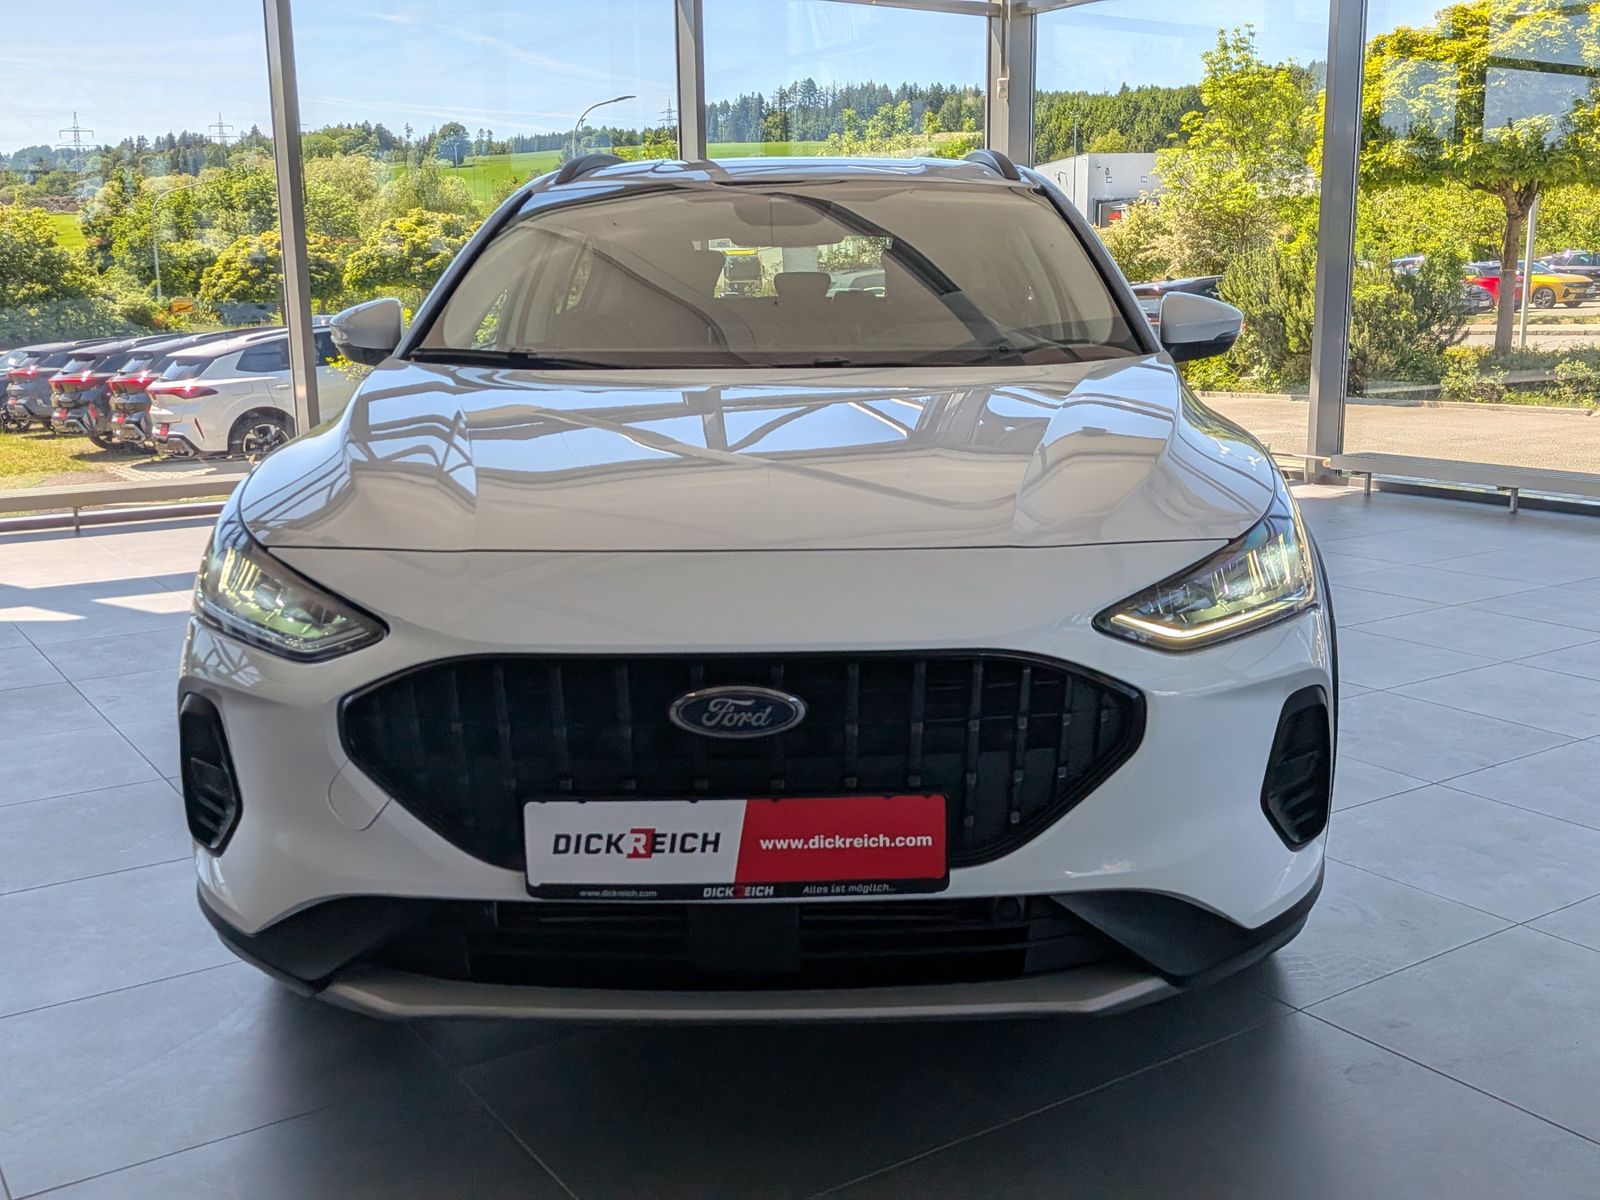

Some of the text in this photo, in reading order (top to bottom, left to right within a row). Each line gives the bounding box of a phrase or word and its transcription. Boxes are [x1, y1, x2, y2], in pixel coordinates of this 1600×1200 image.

[702, 698, 772, 727] Ford
[552, 830, 721, 857] DICKREICH
[760, 834, 932, 850] www.dickreich.com
[703, 886, 774, 898] DICKEICH
[803, 885, 828, 895] Alles
[831, 884, 846, 894] ist
